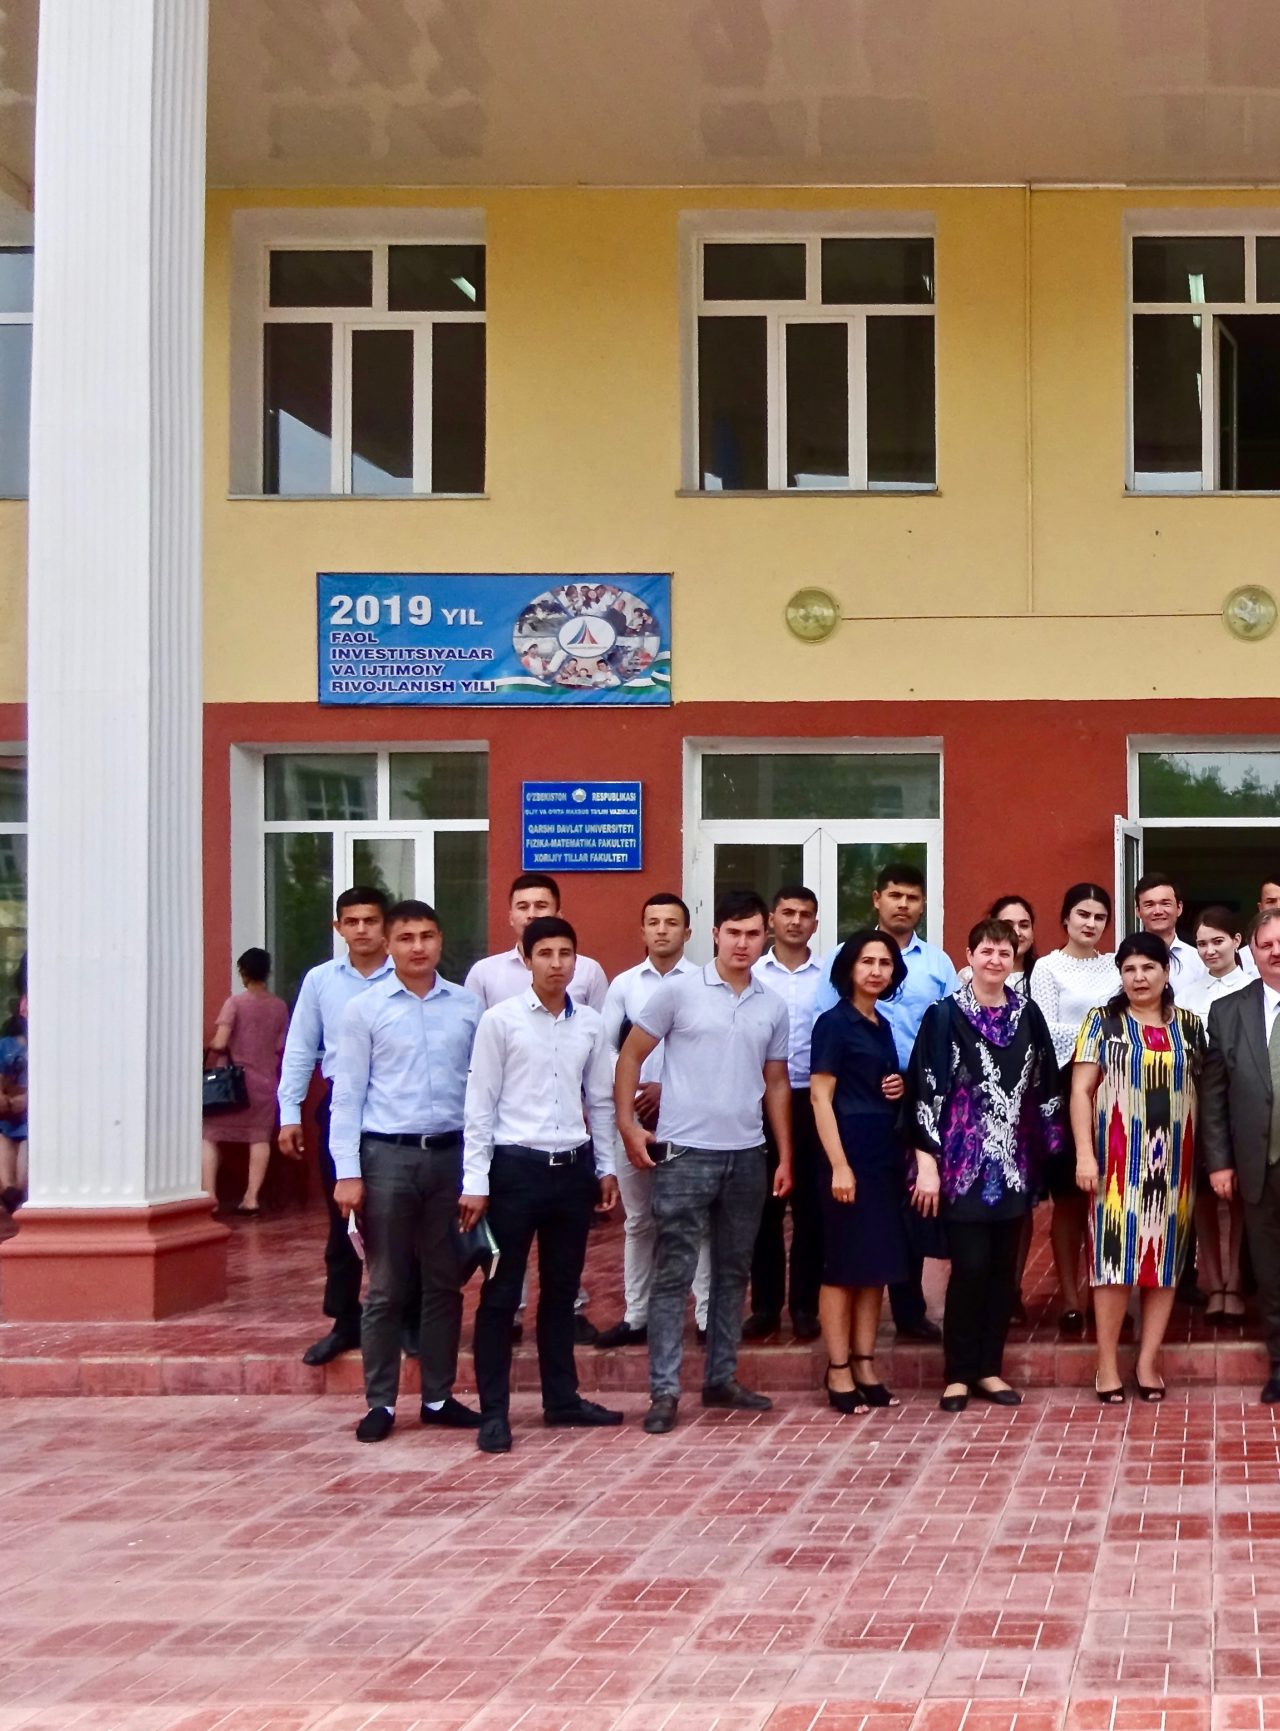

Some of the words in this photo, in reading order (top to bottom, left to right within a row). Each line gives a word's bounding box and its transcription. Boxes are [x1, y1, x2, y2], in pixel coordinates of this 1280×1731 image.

[330, 594, 432, 627] 2019
[440, 608, 484, 626] YIL
[331, 631, 379, 645] FAOL
[331, 647, 494, 661] INVESTITSIYALAR
[330, 664, 359, 677] VA
[360, 664, 445, 677] IJTIMOIY
[331, 679, 457, 693] RIVOJLANISH
[460, 679, 497, 693] YILI
[592, 792, 637, 802] RESPUBLIKASI
[528, 824, 556, 834] QARSHI
[556, 824, 583, 834] DAVLAT
[585, 824, 634, 834] UNIVERSITETI
[525, 839, 597, 848] FIZIKA-MATEMATIKA
[598, 839, 636, 848] FAKULTETI
[534, 853, 563, 863] XORIJIY
[564, 853, 589, 863] TILLAR
[590, 853, 629, 862] FAKULTETI
